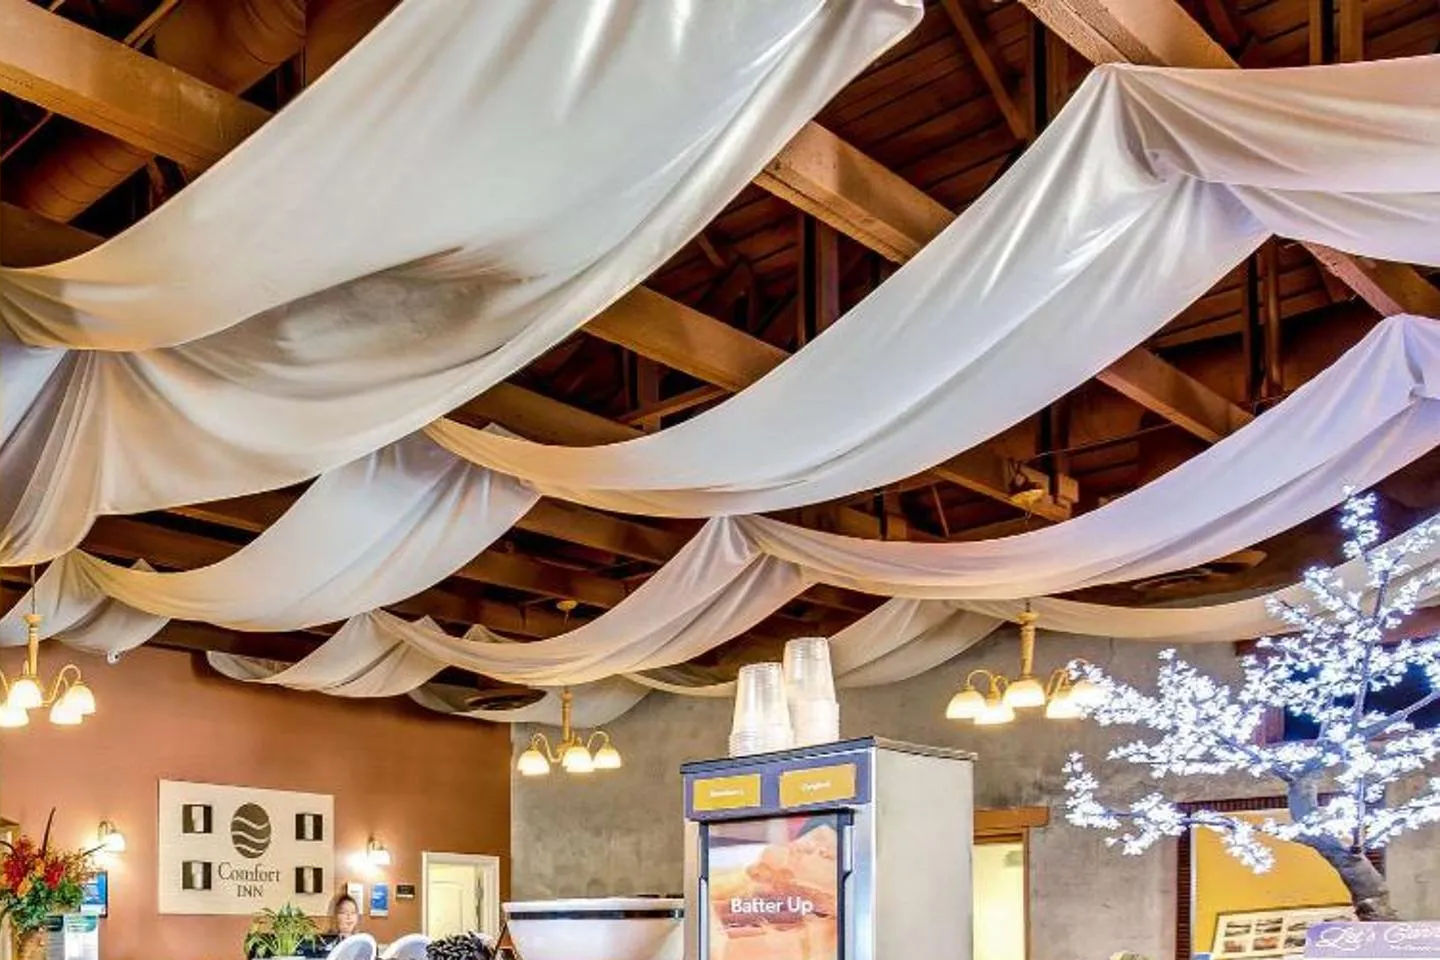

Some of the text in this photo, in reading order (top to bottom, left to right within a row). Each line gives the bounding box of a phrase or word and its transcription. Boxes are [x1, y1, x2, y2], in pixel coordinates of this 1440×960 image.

[218, 861, 280, 882] Comfort
[237, 884, 263, 897] INN
[730, 896, 813, 917] Batter Up
